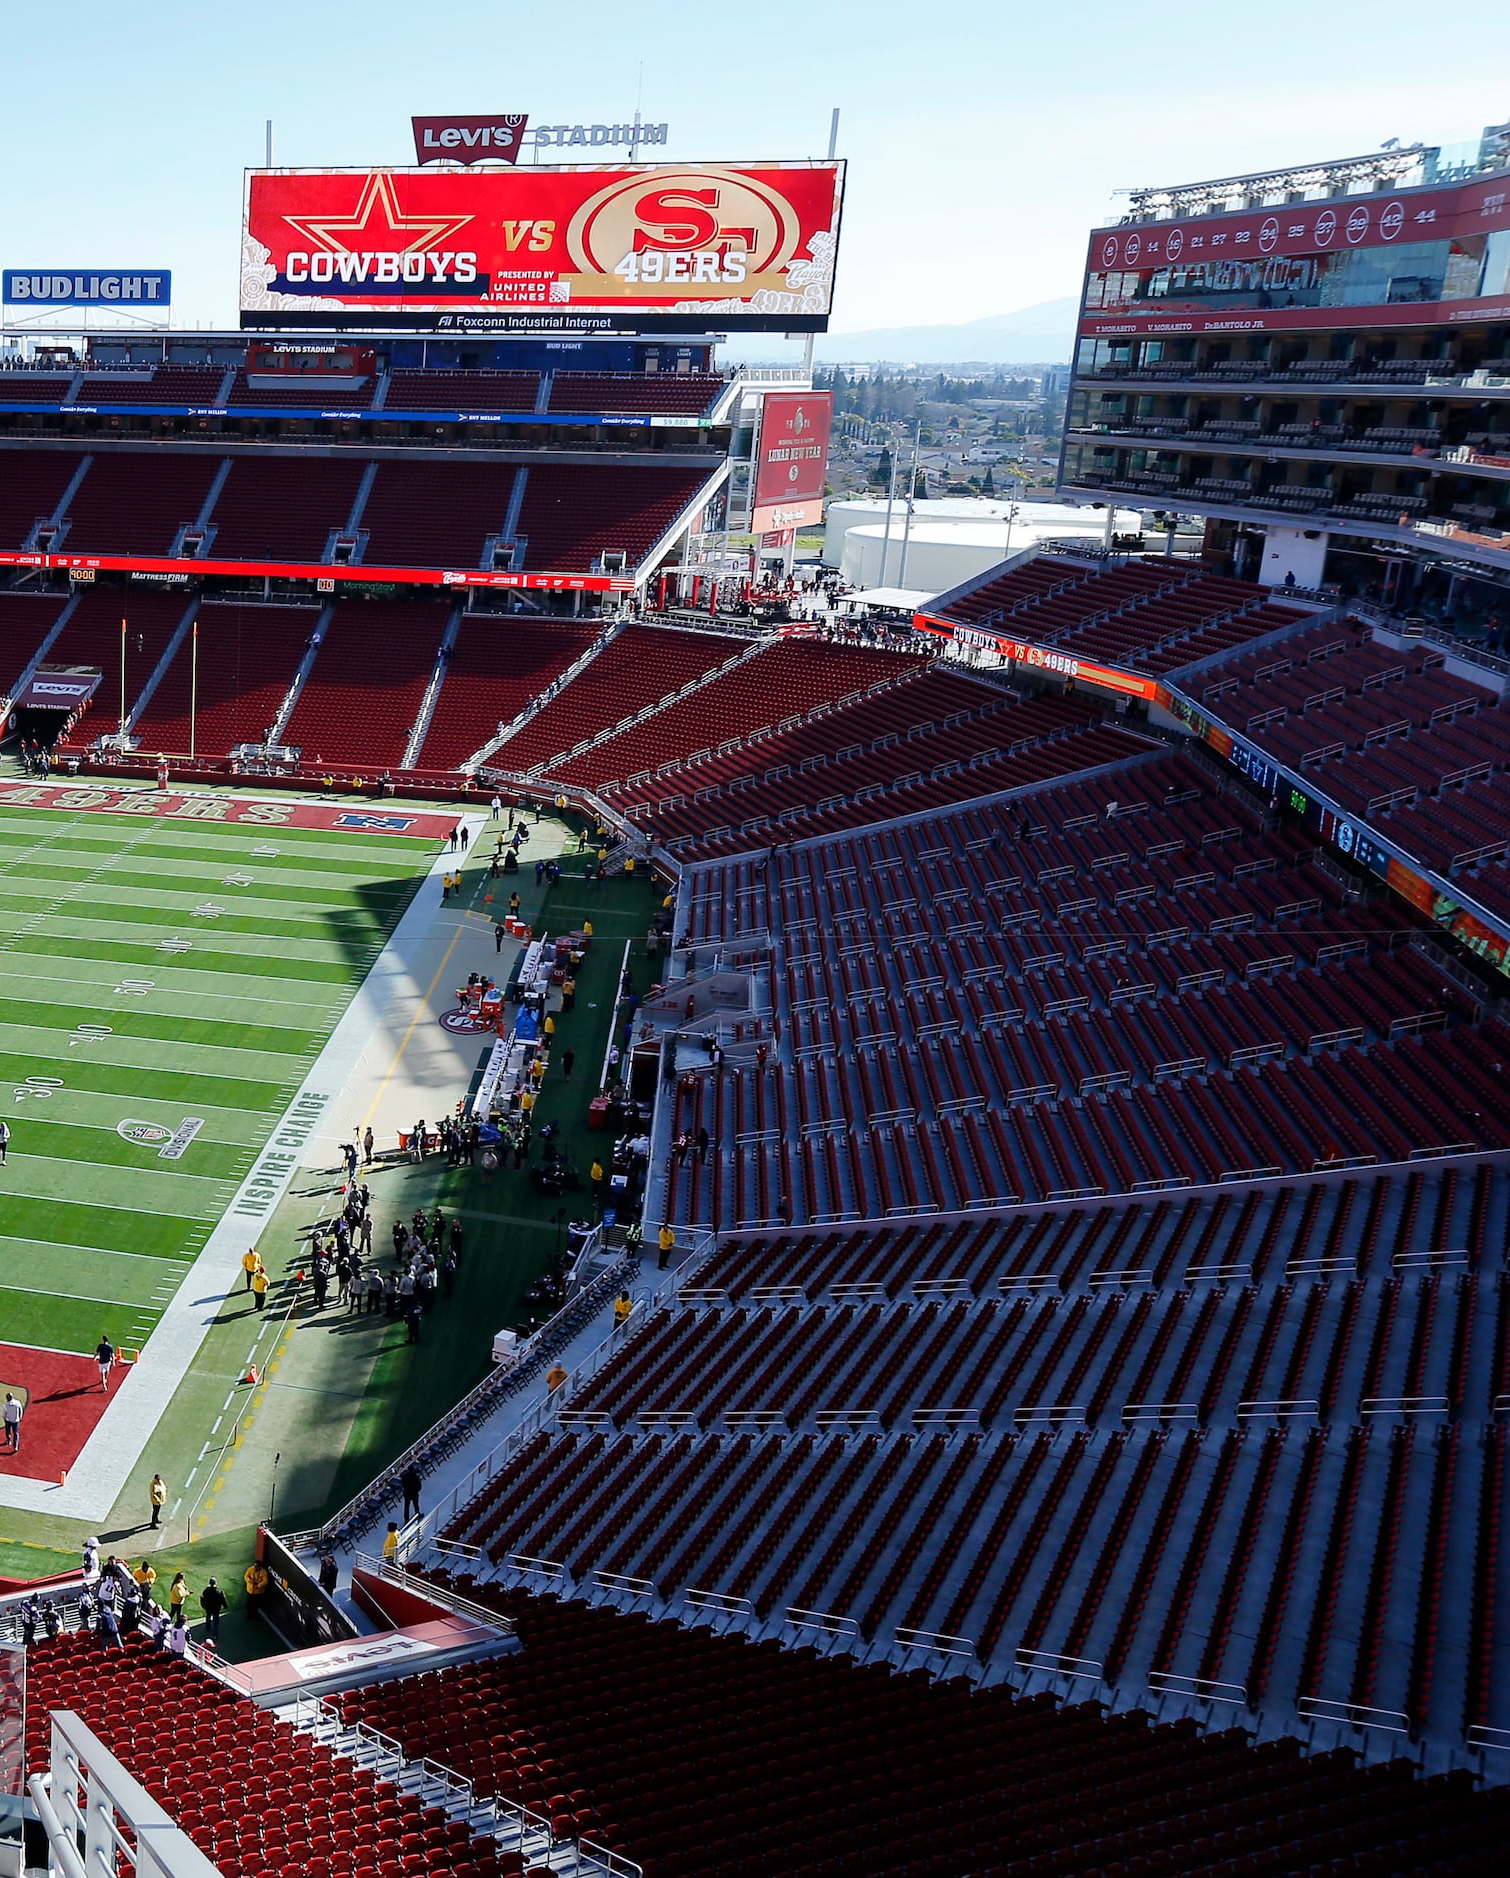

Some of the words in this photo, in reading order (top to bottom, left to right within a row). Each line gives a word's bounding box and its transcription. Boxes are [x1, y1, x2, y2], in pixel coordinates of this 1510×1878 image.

[535, 124, 668, 147] STADIUM
[1414, 209, 1436, 224] 44
[502, 220, 556, 252] VS
[286, 252, 477, 283] COWBOYS
[498, 271, 541, 279] PRESENTED
[542, 271, 554, 279] BY
[614, 252, 747, 283] 49ERS
[11, 276, 73, 299] BUD
[74, 276, 161, 299] LIGHT
[494, 283, 545, 292] UNITED
[480, 293, 545, 302] AIRLINES
[456, 316, 506, 327] Foxconn
[509, 317, 564, 328] Industrial
[566, 318, 612, 328] Internet
[302, 346, 335, 354] STADIUM
[768, 449, 790, 462] LUNAR
[790, 447, 804, 461] NEW
[805, 446, 821, 459] YEAR
[70, 569, 94, 579] 90:00
[953, 627, 996, 651] COWBOYS
[1014, 644, 1025, 660] VS
[1044, 655, 1078, 675] 49ERS
[156, 788, 231, 798] ACISM
[114, 978, 156, 997] 50
[70, 1023, 114, 1041] 40
[16, 1076, 65, 1099] 30
[165, 1120, 200, 1157] DIVISIONAL
[233, 1152, 297, 1217] INSPIRE
[275, 1092, 330, 1147] CHANGE
